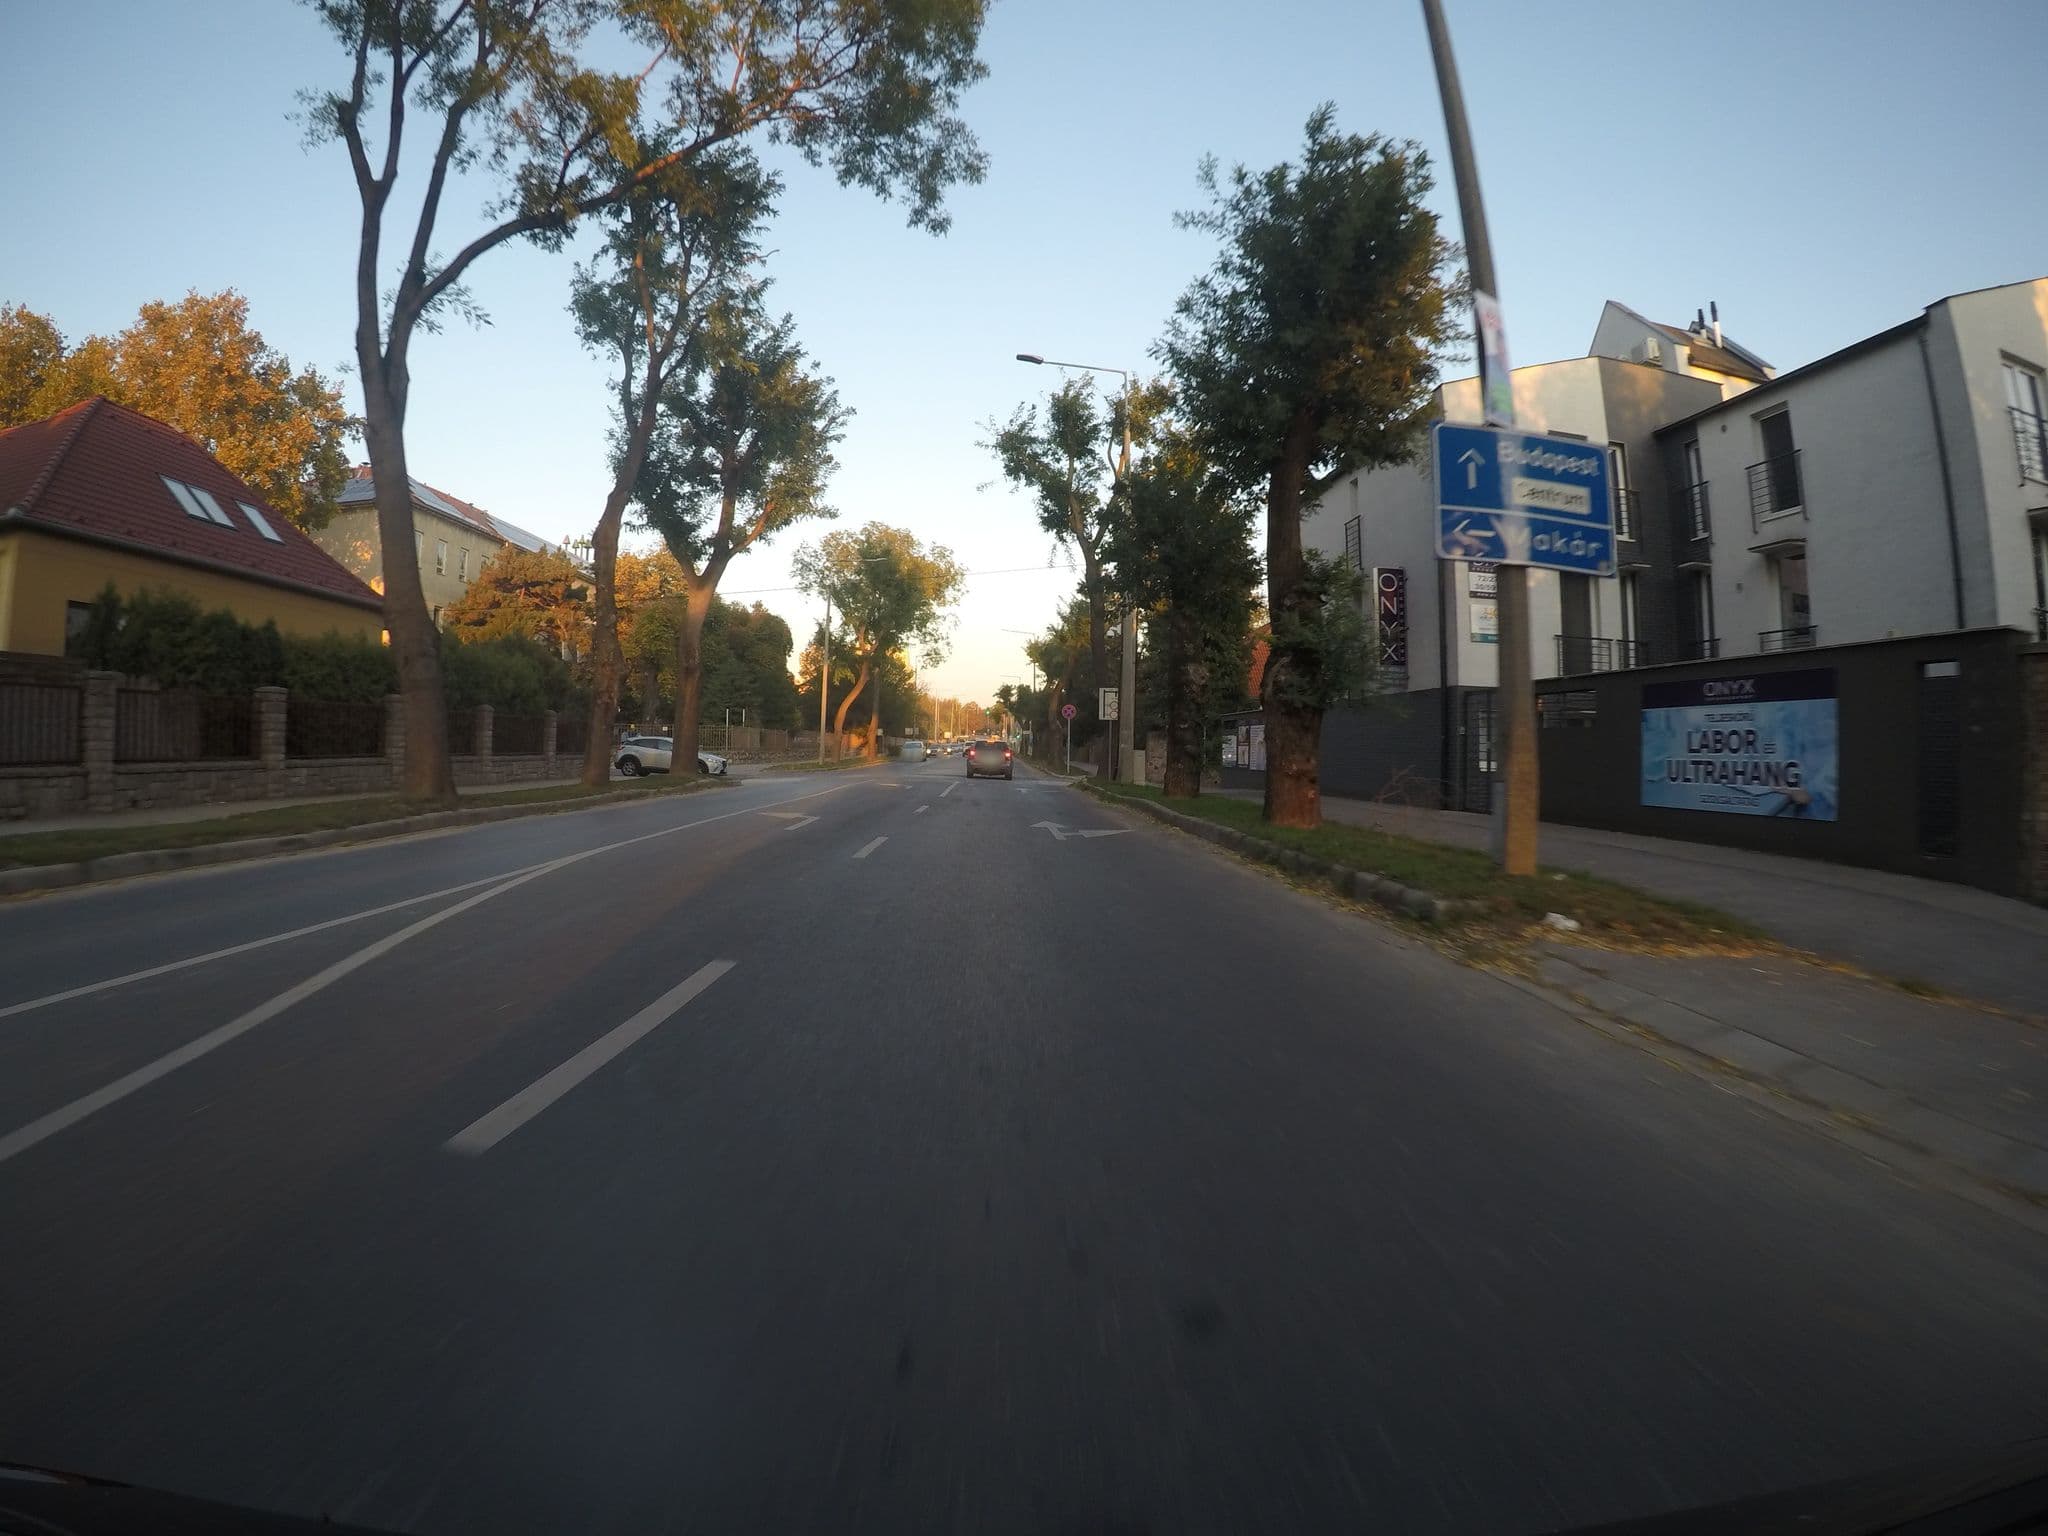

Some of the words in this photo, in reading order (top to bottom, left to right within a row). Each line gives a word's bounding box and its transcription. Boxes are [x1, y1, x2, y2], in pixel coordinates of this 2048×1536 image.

[1497, 440, 1600, 477] Budapest
[1379, 572, 1399, 662] ONYX
[1702, 679, 1756, 697] ONYX
[1686, 729, 1760, 754] LABOR
[1666, 759, 1803, 787] ULTRAHANG
